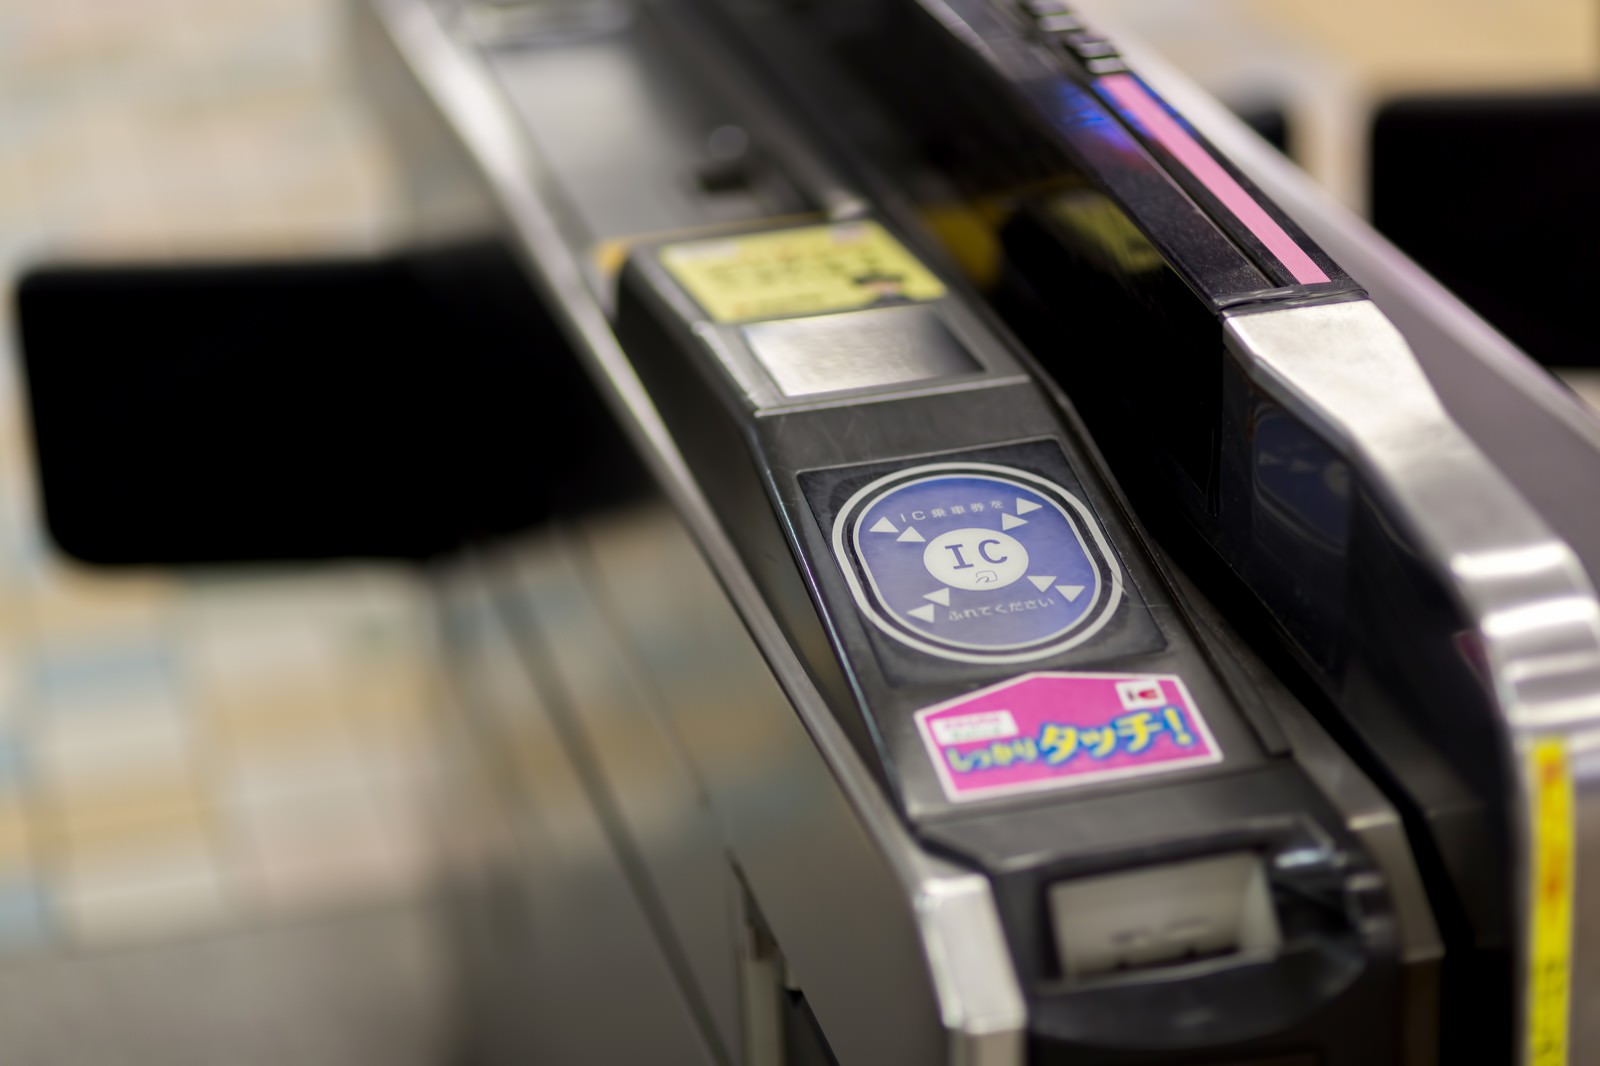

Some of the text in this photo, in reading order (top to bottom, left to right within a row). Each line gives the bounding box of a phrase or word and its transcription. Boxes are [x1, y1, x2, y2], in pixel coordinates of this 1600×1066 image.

[944, 538, 1008, 570] IC
[948, 598, 1055, 621] ふれてください
